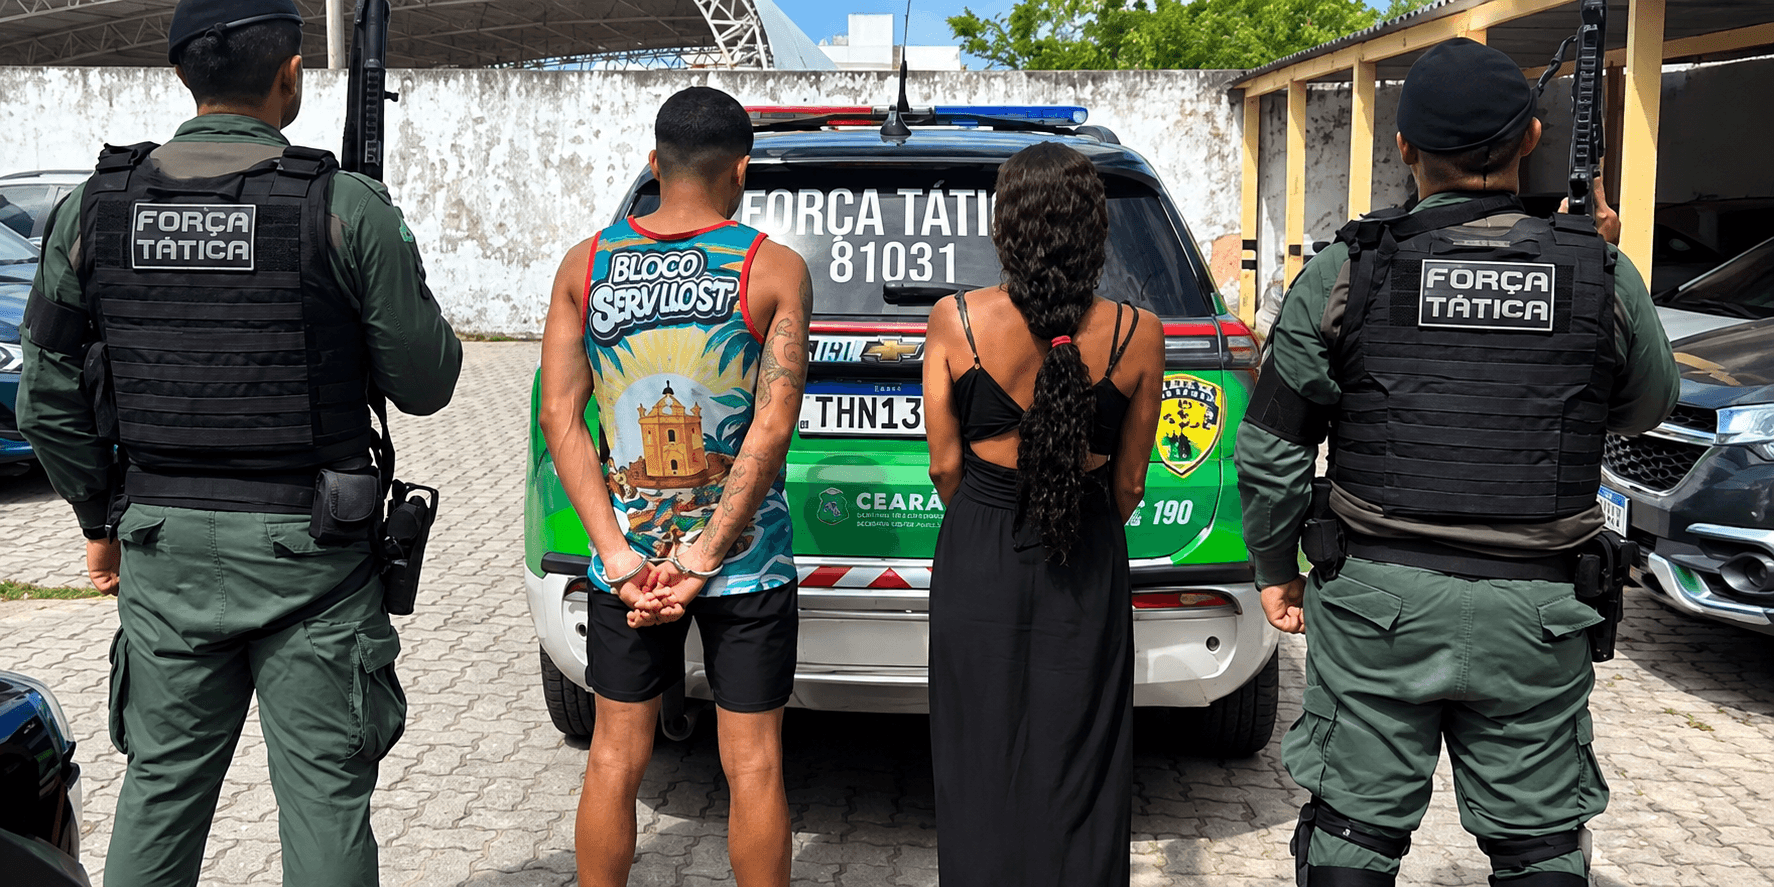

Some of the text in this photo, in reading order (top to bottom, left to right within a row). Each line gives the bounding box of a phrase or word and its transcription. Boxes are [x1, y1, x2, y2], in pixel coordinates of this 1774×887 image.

[137, 211, 249, 237] FORÇA
[740, 179, 1001, 242] FORÇA TÁTI
[137, 236, 249, 260] TÁTICA
[612, 253, 699, 283] BLOCO
[829, 240, 956, 284] 81031
[1426, 267, 1549, 295] FORÇA
[1426, 294, 1549, 321] TÁTICA
[856, 488, 944, 511] CEARÁ
[1152, 500, 1194, 525] 190
